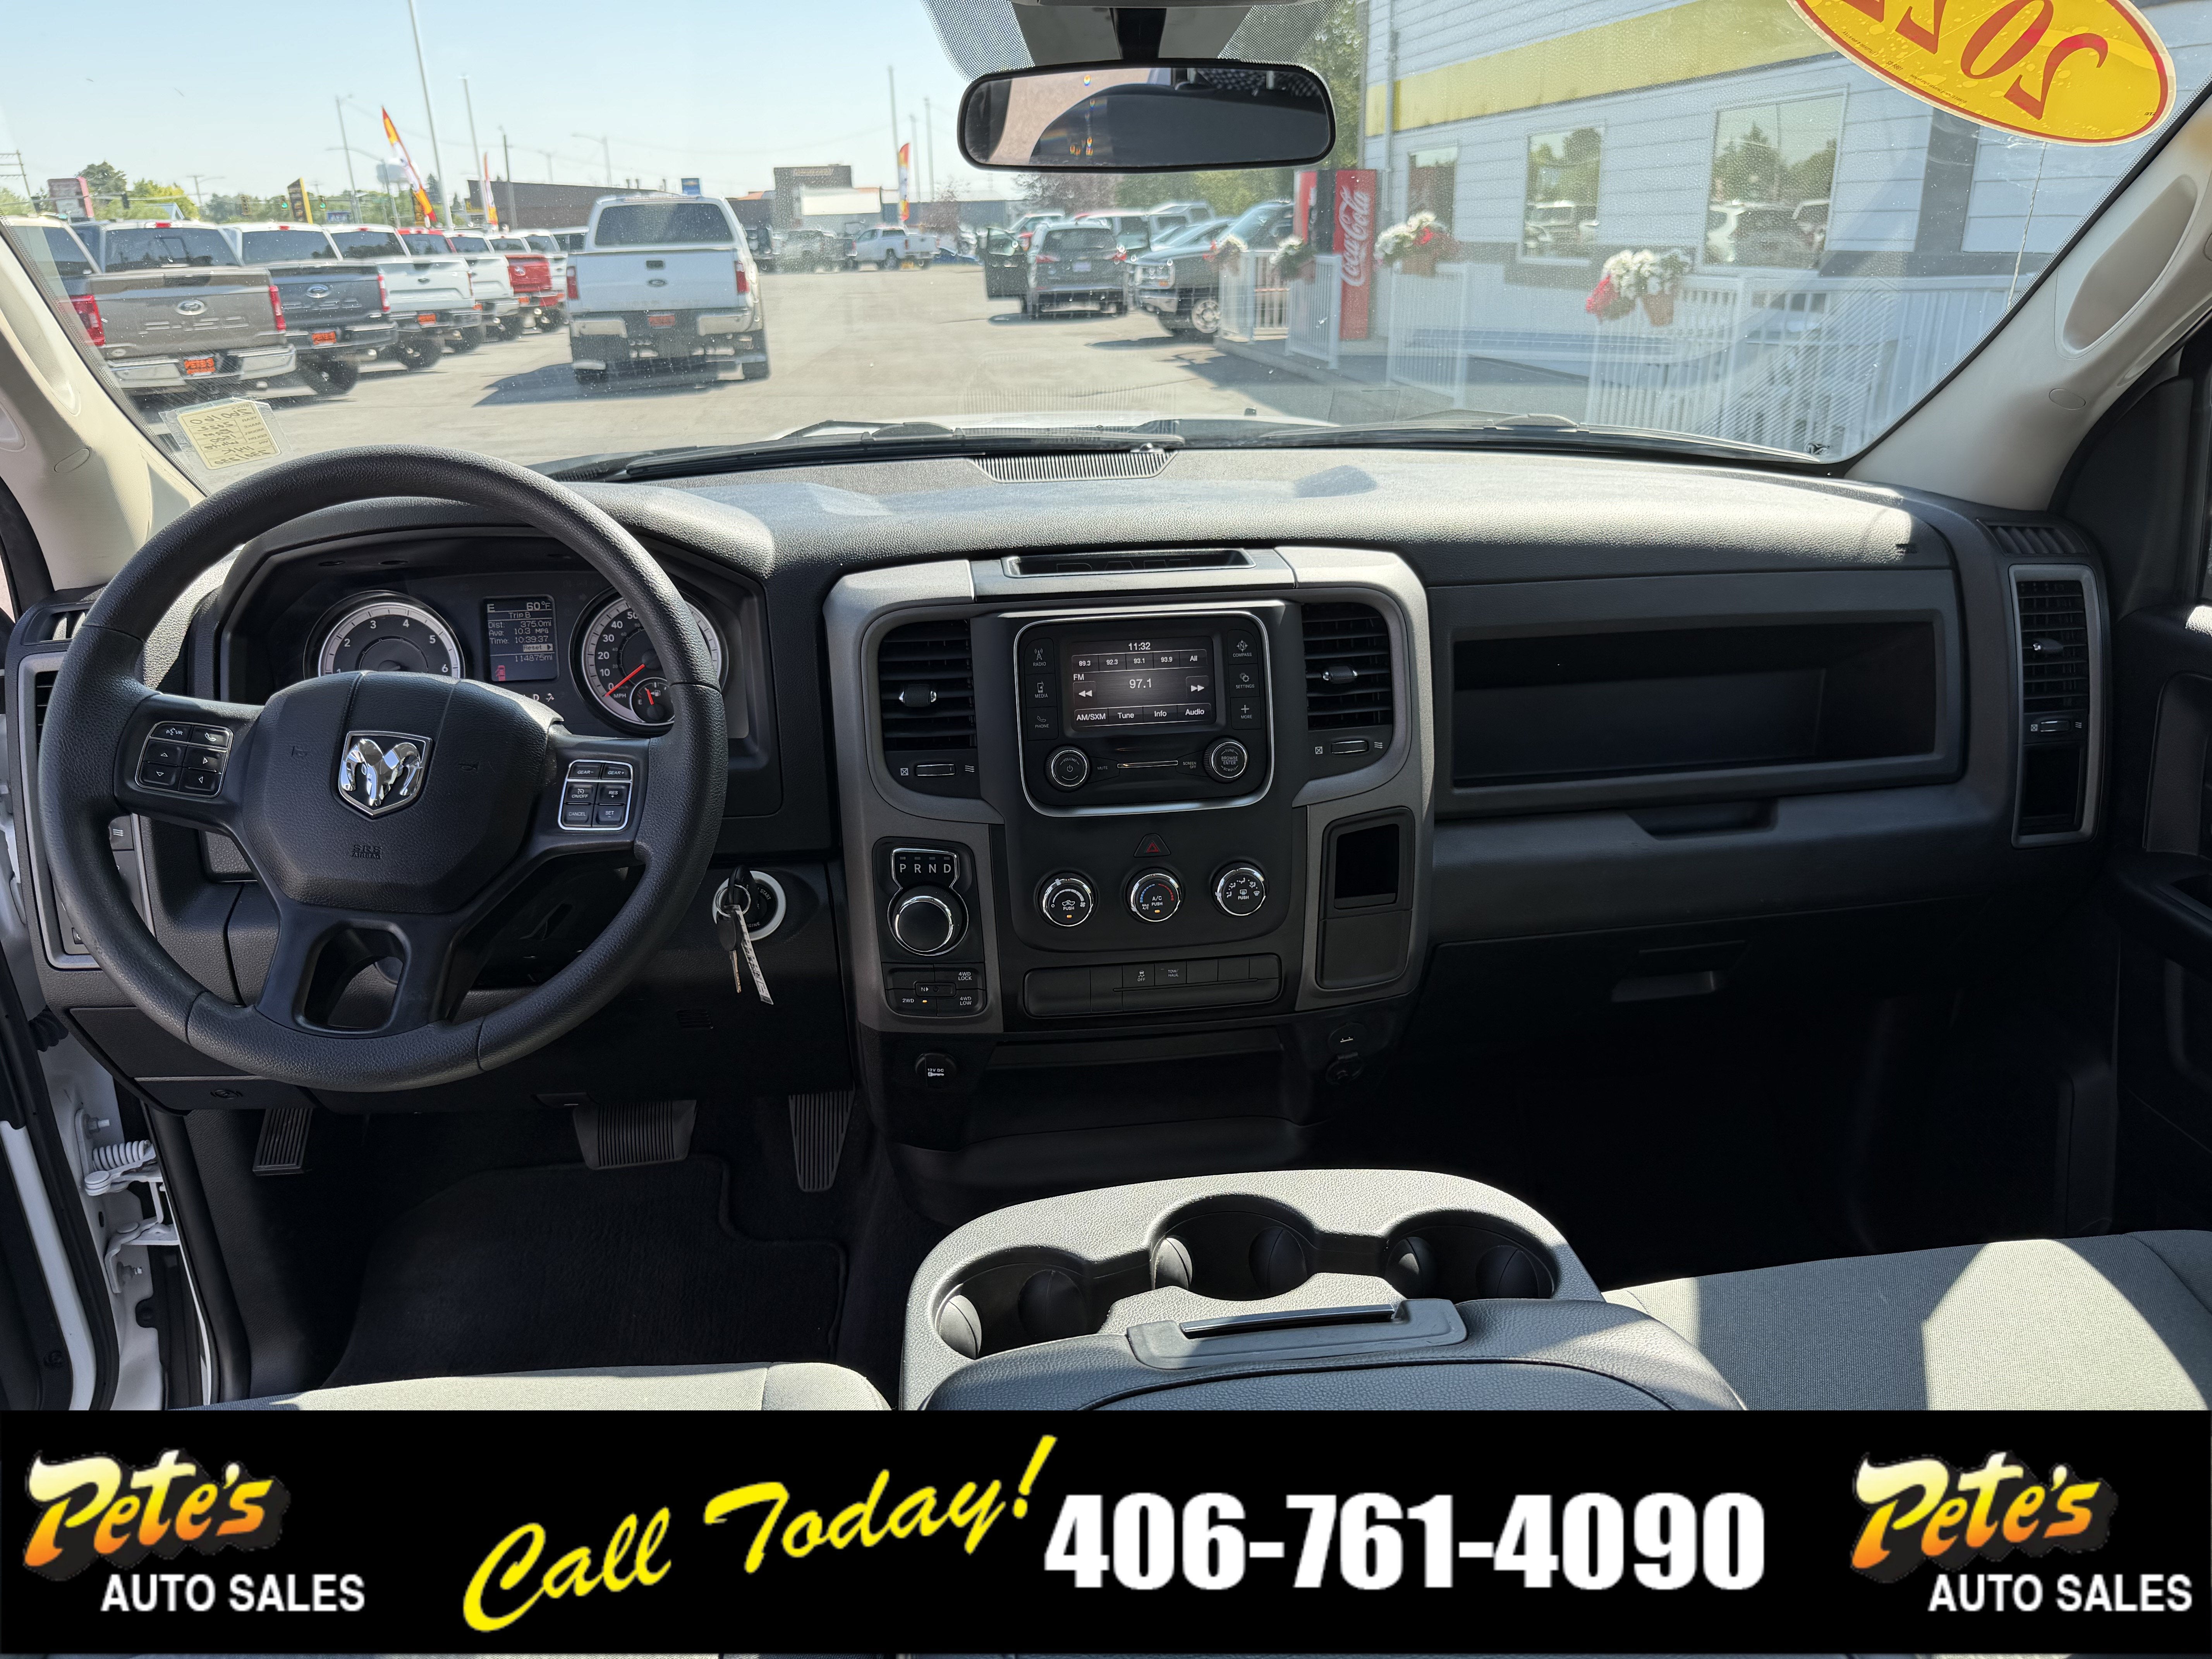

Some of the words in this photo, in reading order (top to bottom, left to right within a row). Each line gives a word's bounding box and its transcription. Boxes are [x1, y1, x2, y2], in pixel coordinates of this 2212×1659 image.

[487, 604, 495, 613] E
[527, 601, 551, 611] 60°F
[370, 620, 376, 629] 3
[403, 619, 410, 628] 4
[429, 635, 436, 644] 5
[515, 635, 548, 644] 10:39:37
[603, 634, 615, 642] 30
[344, 639, 350, 647] 2
[1128, 642, 1151, 651] 11:32
[598, 651, 610, 659] 20
[441, 664, 448, 673] 6
[600, 668, 610, 677] 10
[608, 682, 614, 690] 0
[1129, 678, 1152, 689] 97.1
[1076, 713, 1106, 721] AM/SXM
[1185, 708, 1205, 716] Audio
[353, 844, 382, 853] SRS
[900, 864, 907, 873] P
[914, 864, 922, 873] R
[929, 864, 936, 873] N
[944, 864, 951, 873] D
[760, 889, 771, 900] START
